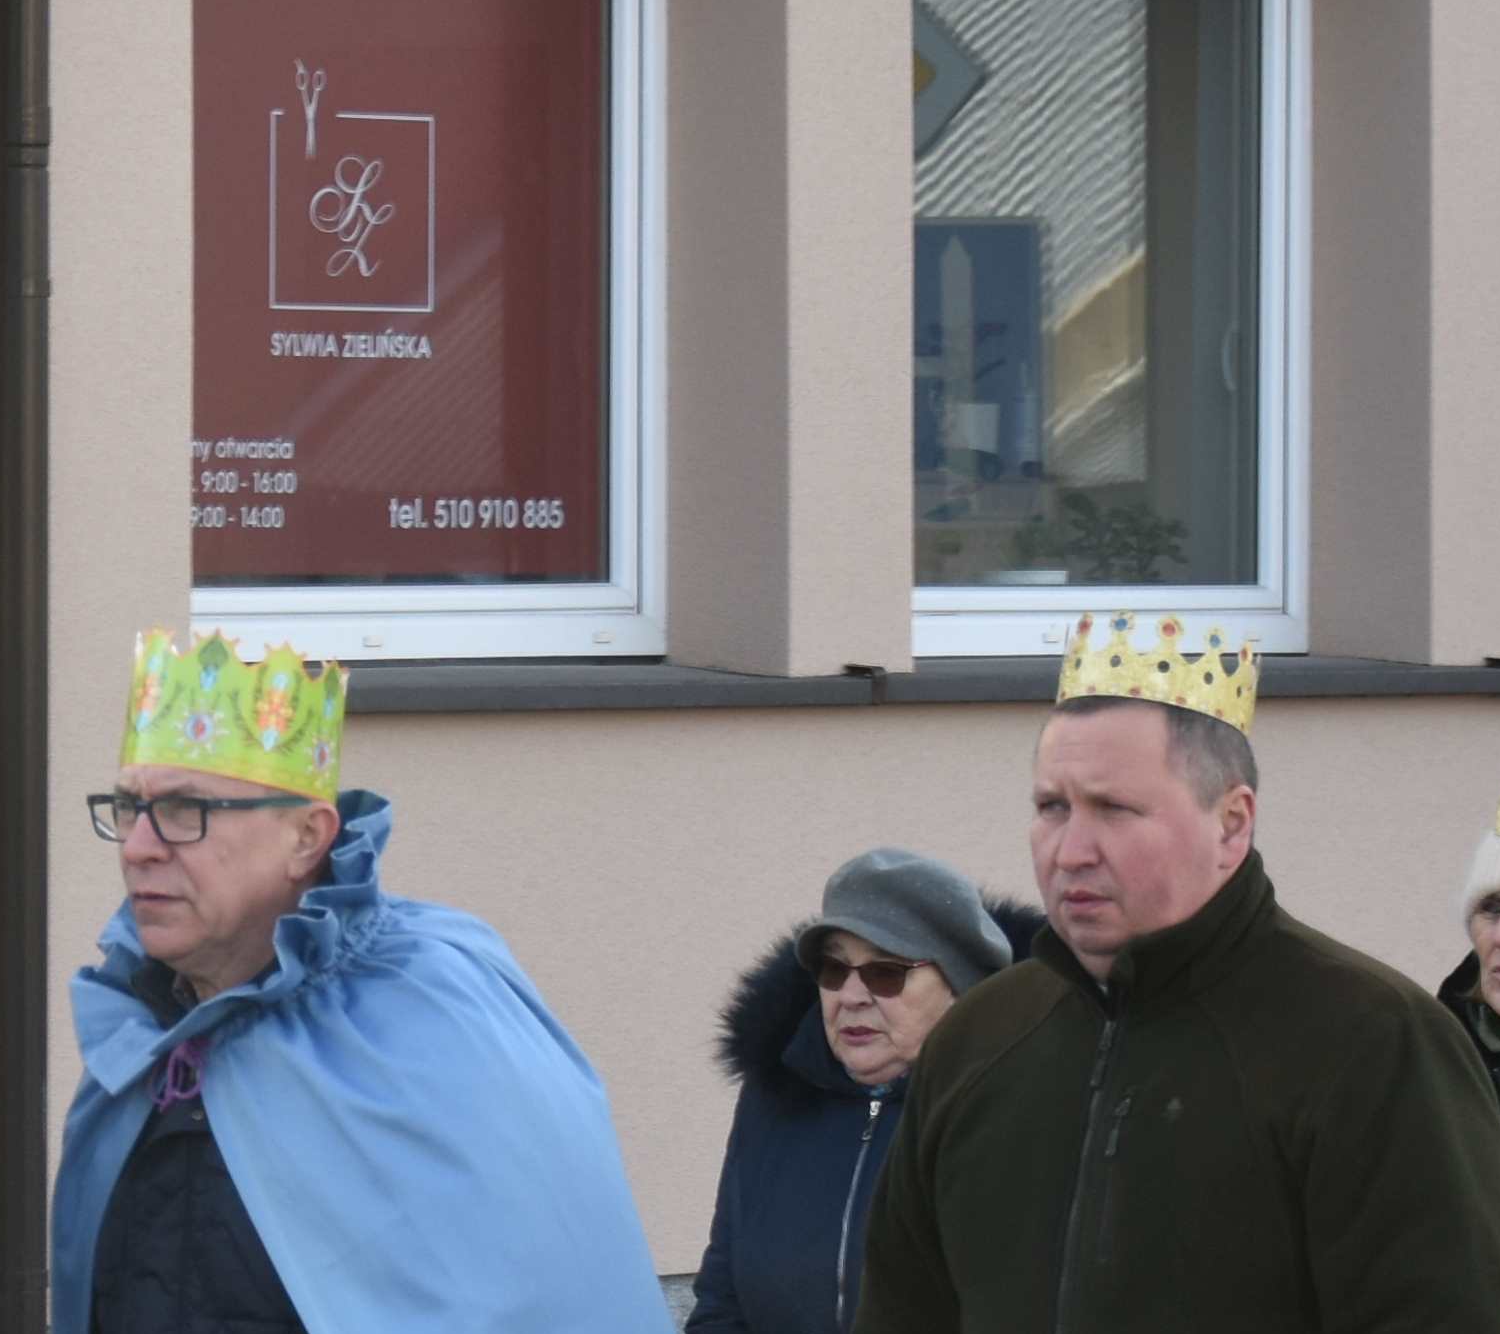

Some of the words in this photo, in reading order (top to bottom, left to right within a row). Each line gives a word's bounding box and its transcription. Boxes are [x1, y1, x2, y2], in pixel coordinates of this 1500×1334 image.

[270, 332, 338, 357] SYLWIA
[342, 327, 432, 358] ZIELIŃSKA
[215, 437, 295, 459] otwarcia
[201, 471, 239, 493] 9:00
[252, 471, 297, 494] 16:00
[240, 505, 285, 528] 14:00
[389, 498, 428, 529] tel.
[434, 499, 474, 529] 510
[478, 499, 519, 529] 910
[522, 499, 564, 529] 885
